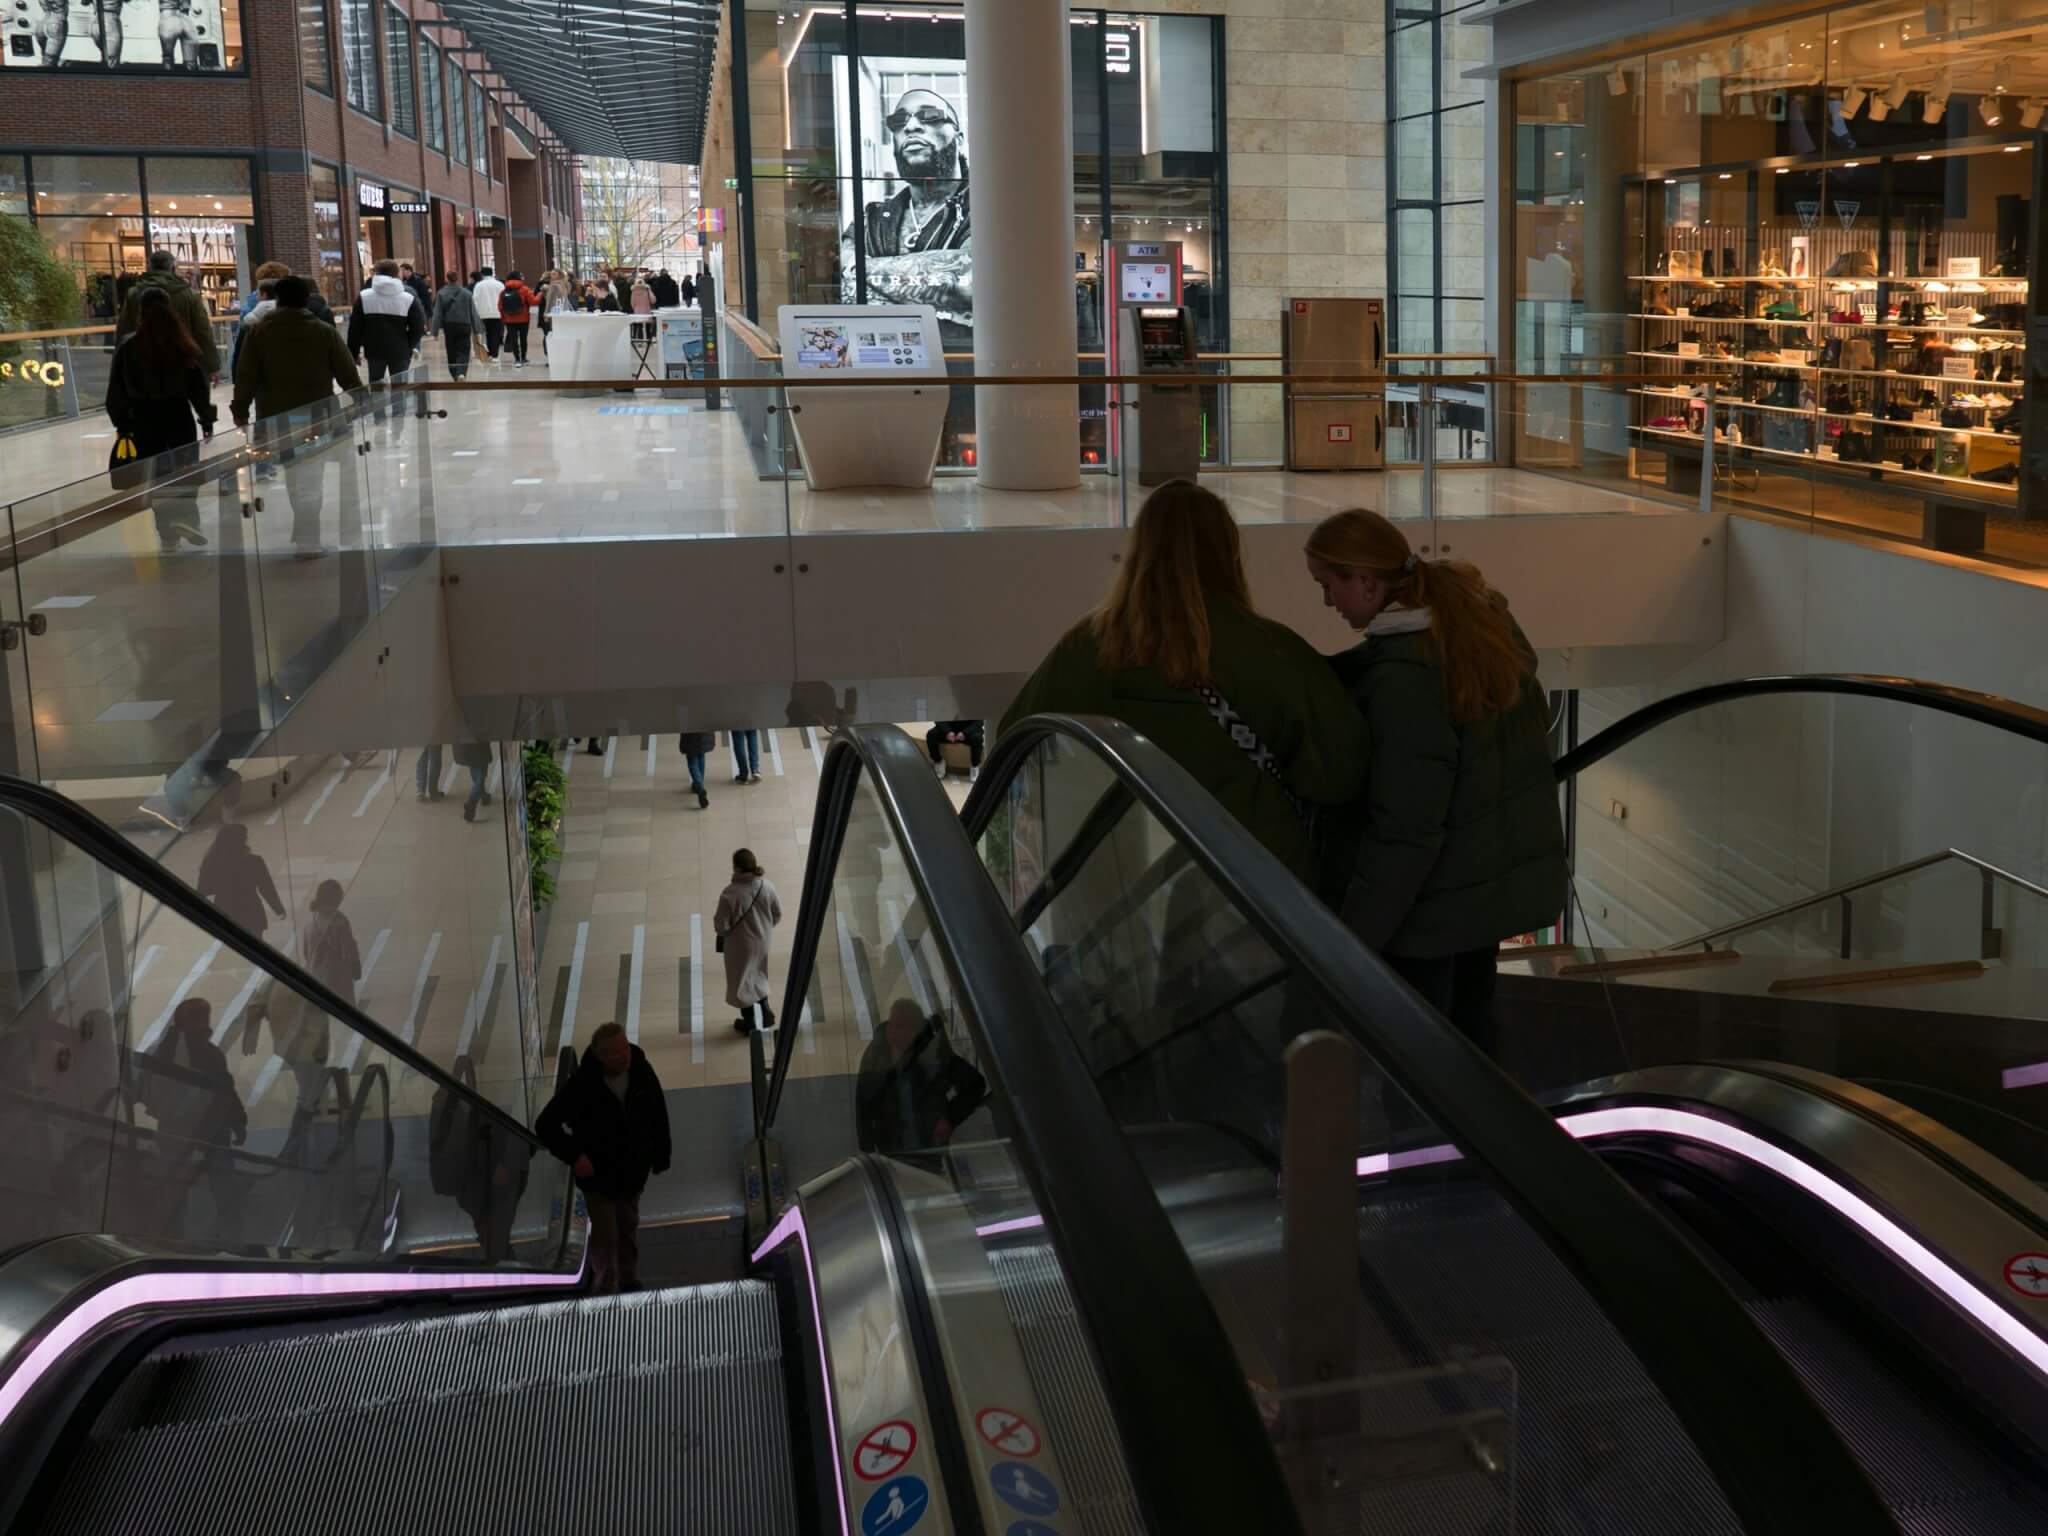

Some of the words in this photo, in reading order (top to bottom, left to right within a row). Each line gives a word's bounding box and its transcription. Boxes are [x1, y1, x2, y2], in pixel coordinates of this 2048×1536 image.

[361, 184, 384, 209] GUESS
[392, 204, 427, 212] GUESS
[1138, 246, 1160, 255] ATM
[868, 275, 942, 286] URNA
